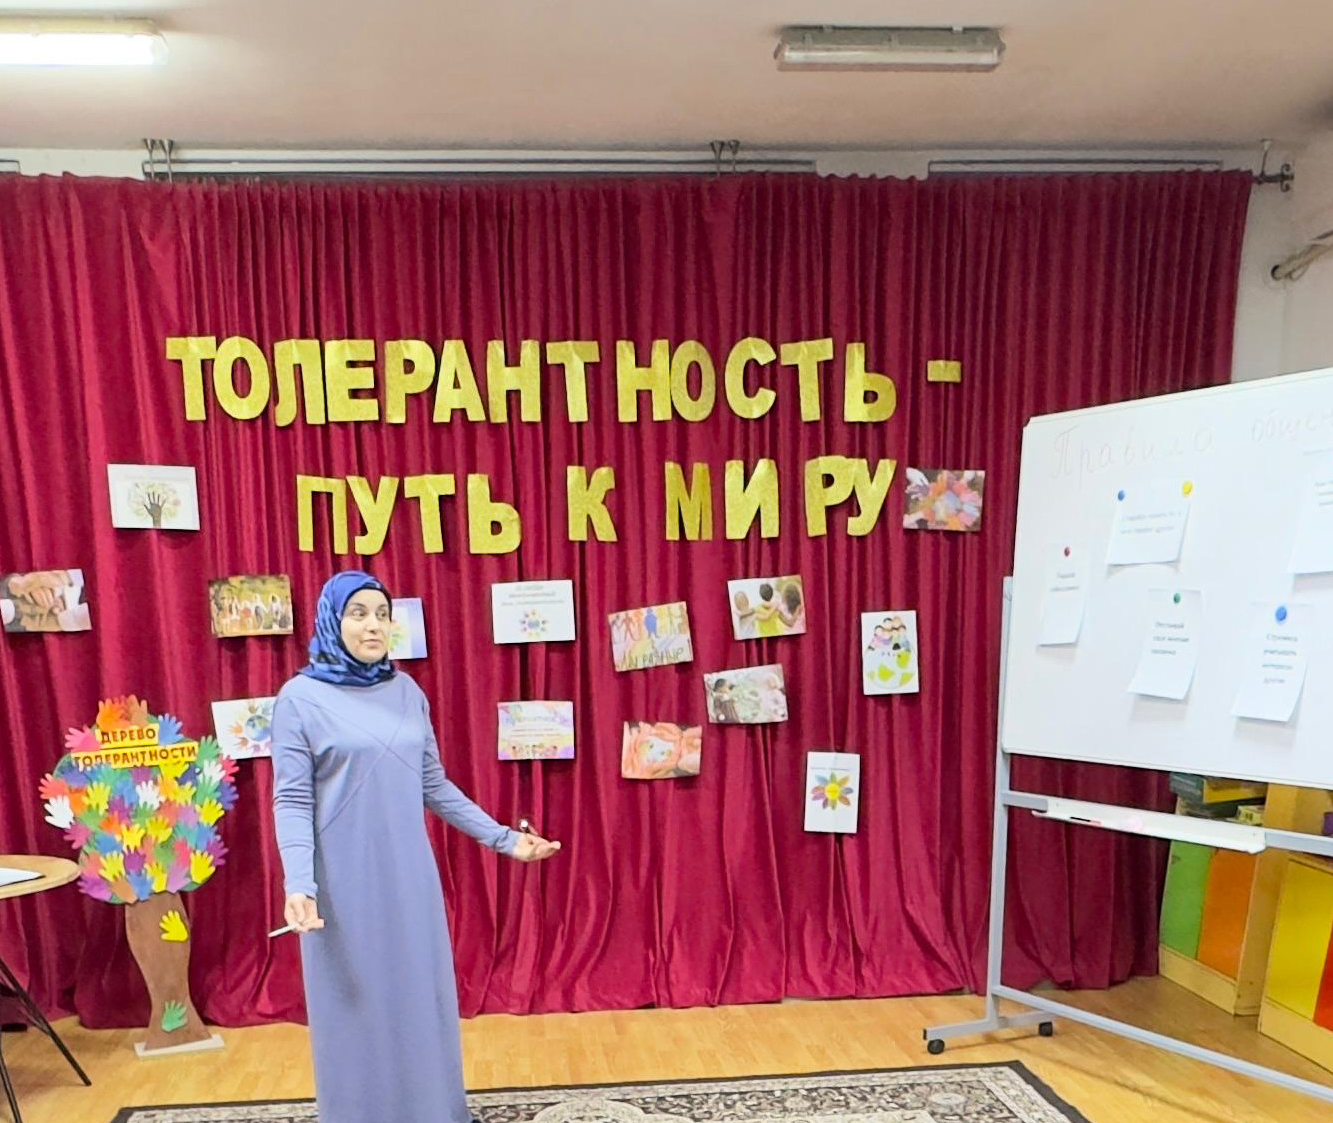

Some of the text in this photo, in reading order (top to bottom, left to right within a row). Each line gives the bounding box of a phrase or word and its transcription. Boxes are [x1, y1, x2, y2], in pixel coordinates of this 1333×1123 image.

[166, 336, 896, 426] ТОЛЕРАНТНОСТЬ
[296, 473, 522, 556] ПУТЬ
[567, 466, 616, 542] К
[100, 728, 156, 744] ДЕРЕВО
